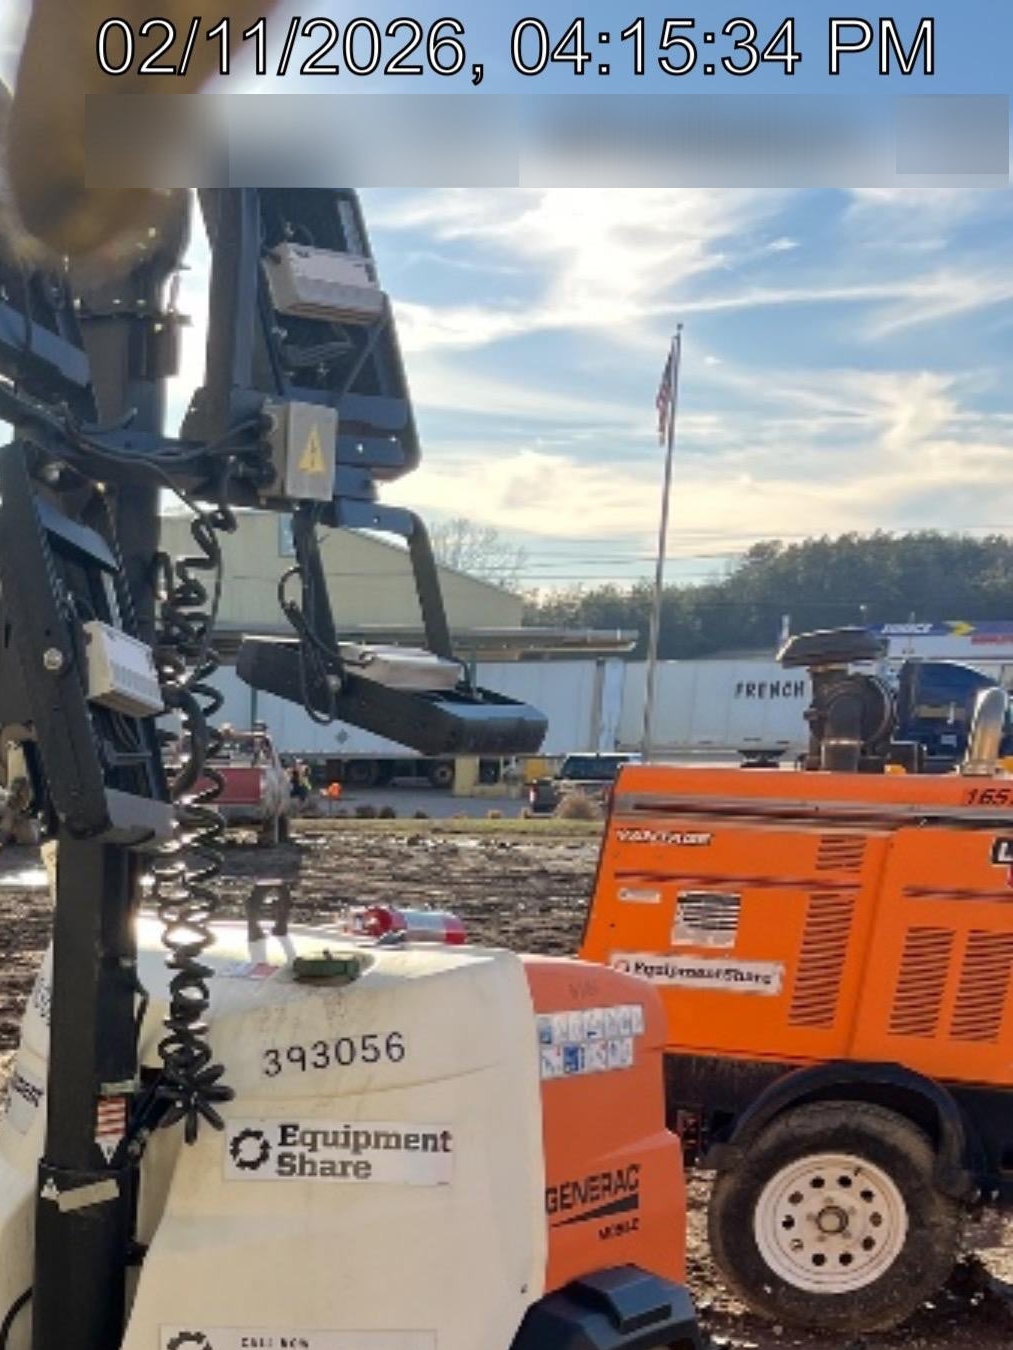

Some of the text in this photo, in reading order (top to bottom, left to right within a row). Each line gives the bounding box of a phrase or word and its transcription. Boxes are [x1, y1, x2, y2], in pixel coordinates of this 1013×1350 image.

[262, 1030, 406, 1078] 393056
[276, 1123, 453, 1155] Equipment
[275, 1151, 372, 1179] Share
[544, 1163, 641, 1216] GENERAC
